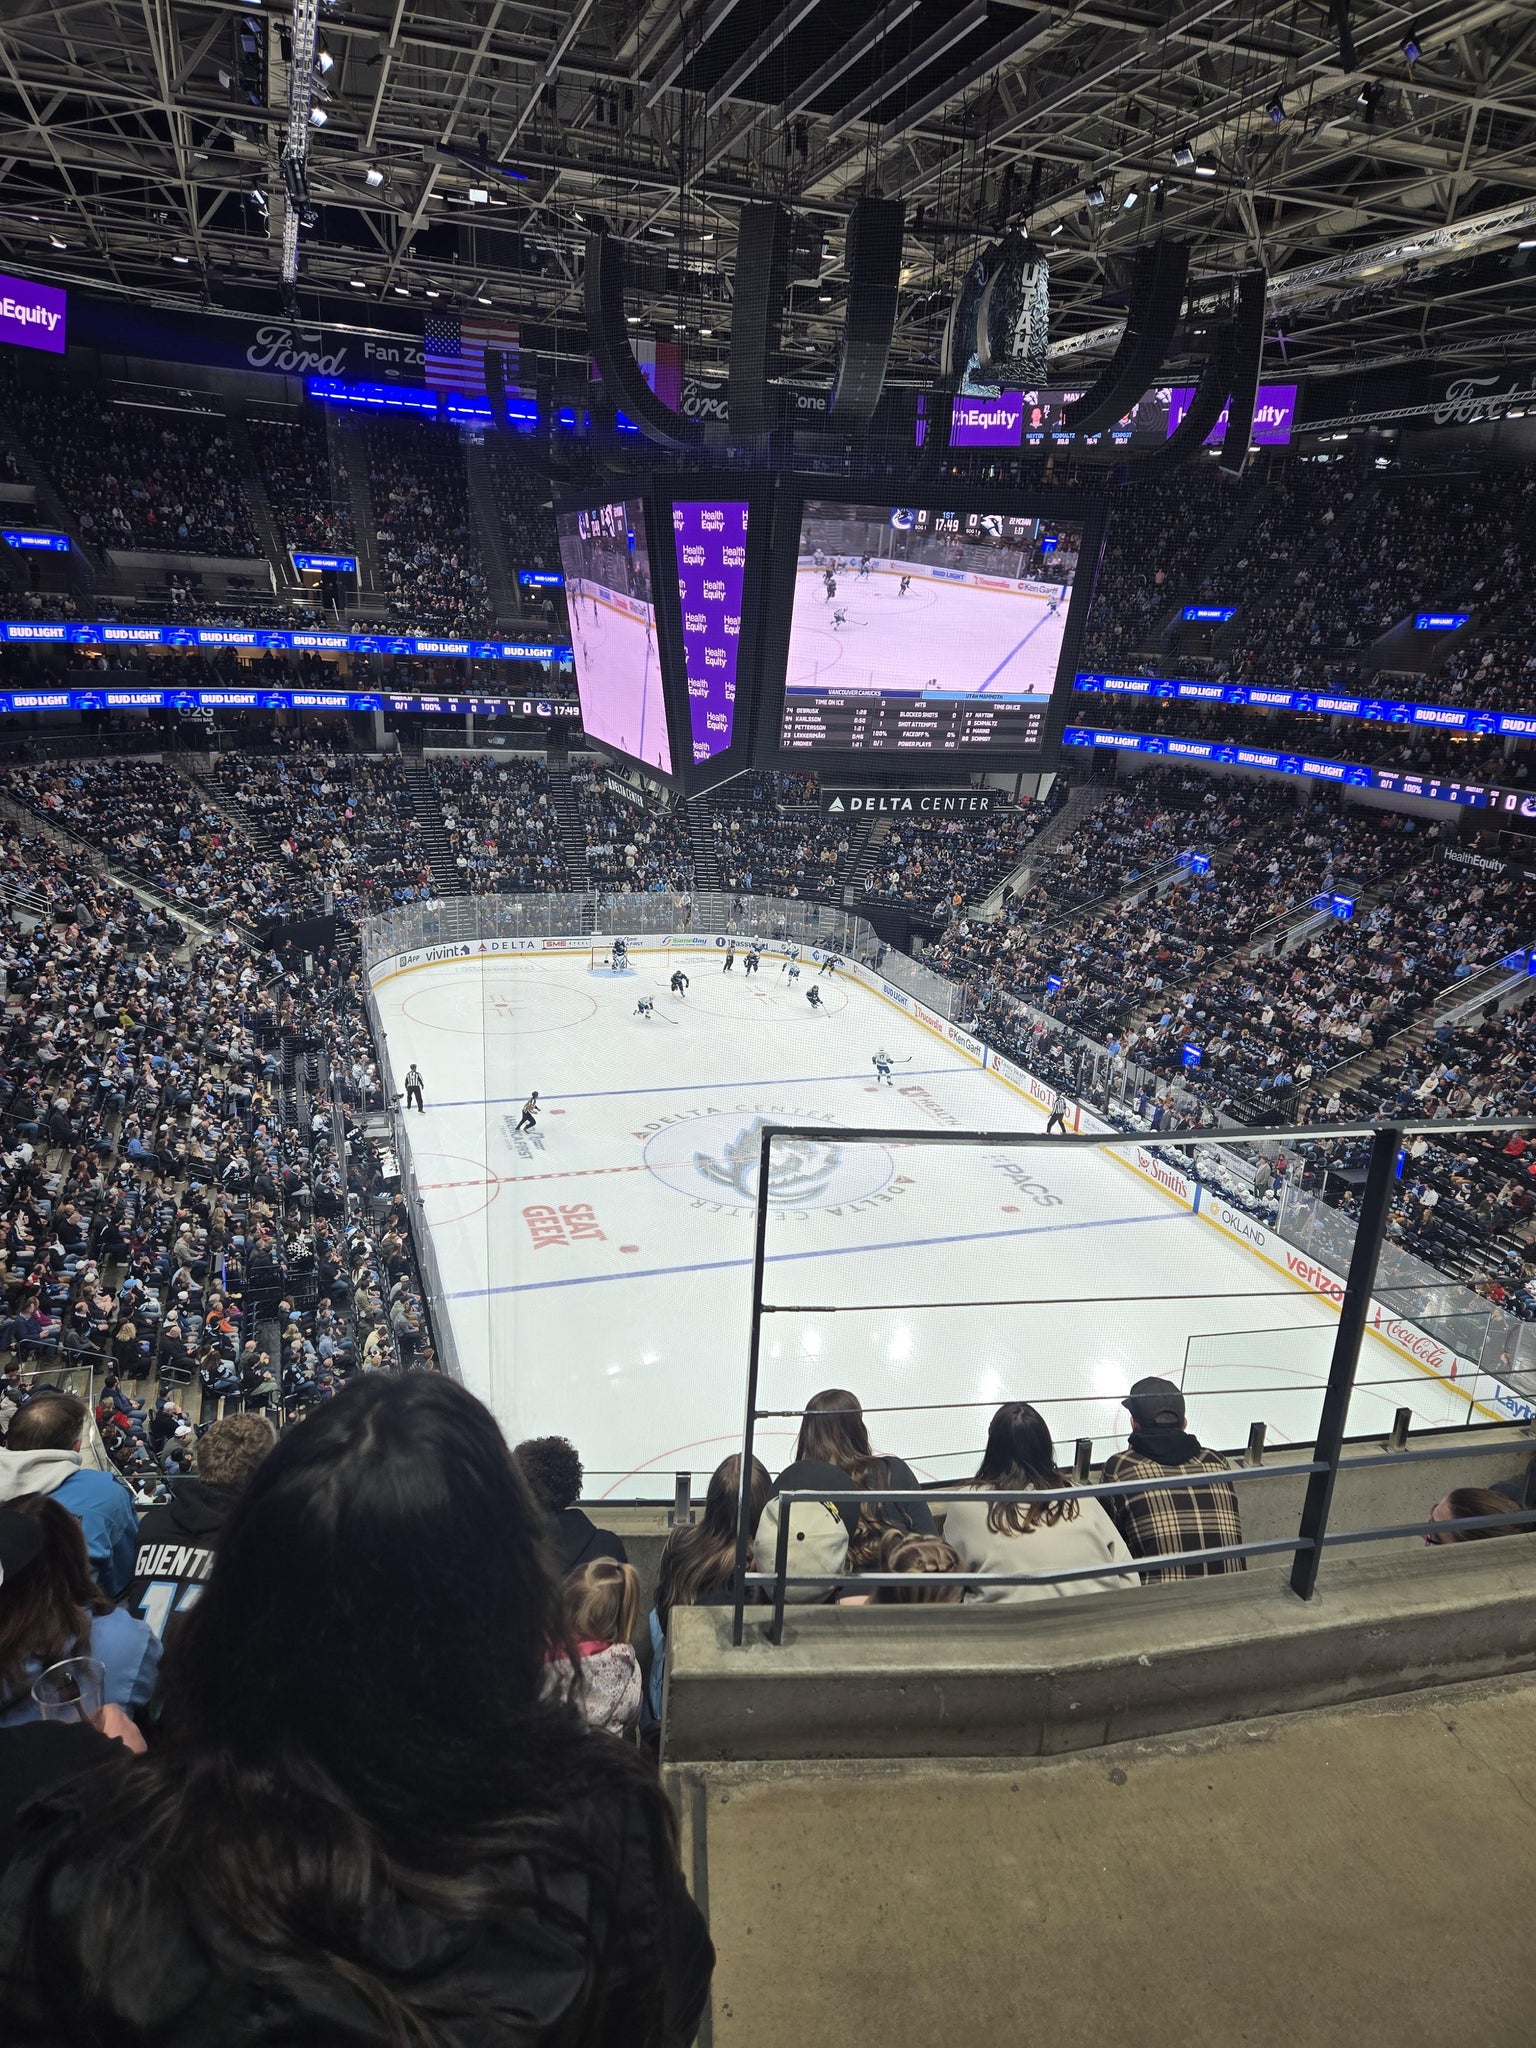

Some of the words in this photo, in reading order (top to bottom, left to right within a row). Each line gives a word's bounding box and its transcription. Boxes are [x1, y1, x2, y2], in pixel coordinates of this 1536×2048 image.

[1012, 262, 1040, 358] UTAH
[247, 326, 347, 376] Ford
[364, 342, 399, 362] Fan
[403, 351, 426, 366] Zo
[796, 391, 826, 410] one
[701, 510, 724, 520] Health
[935, 518, 959, 532] 17:49
[682, 544, 704, 555] Health
[703, 580, 724, 590] Health
[686, 612, 706, 623] Health
[9, 628, 34, 637] BUD
[34, 628, 64, 638] LIGHT
[105, 630, 128, 639] BUD
[130, 630, 160, 640] LIGHT
[200, 633, 223, 641] BUD
[224, 634, 254, 643] LIGHT
[293, 636, 316, 646] BUD
[317, 637, 347, 647] LIGHT
[418, 643, 439, 652] BUD
[439, 644, 468, 653] LIGHT
[504, 647, 524, 656] BUD
[525, 648, 552, 658] LIGHT
[705, 647, 726, 658] Health
[688, 678, 708, 688] Health
[1106, 680, 1124, 689] BUD
[1125, 682, 1149, 691] LIGHT
[1180, 686, 1198, 695] BUD
[1199, 688, 1222, 697] LIGHT
[14, 697, 38, 707] BUD
[39, 696, 68, 705] LIGHT
[108, 695, 131, 704] BUD
[132, 694, 162, 704] LIGHT
[201, 695, 224, 703] BUD
[225, 695, 255, 704] LIGHT
[293, 695, 316, 705] BUD
[317, 696, 347, 706] LIGHT
[1251, 692, 1268, 701] BUD
[1268, 694, 1290, 704] LIGHT
[522, 702, 531, 714] 0
[554, 706, 580, 716] 17:49
[1318, 699, 1335, 709] BUD
[1335, 701, 1358, 711] LIGHT
[707, 712, 727, 722] Health
[1416, 710, 1436, 720] BUD
[1437, 712, 1465, 724] LIGHT
[1502, 719, 1525, 731] BUD
[1525, 722, 1536, 732] LI
[1096, 735, 1114, 744] BUD
[1114, 737, 1139, 747] LIGHT
[1169, 743, 1187, 752] BUD
[1187, 744, 1210, 755] LIGHT
[1238, 753, 1255, 762] BUD
[1256, 755, 1278, 765] LIGHT
[1303, 763, 1320, 773] BUD
[1321, 765, 1344, 776] LIGHT
[1380, 779, 1392, 789] 0/1
[1403, 783, 1422, 795] 100%
[1505, 795, 1517, 810] 0
[851, 797, 913, 811] DELTA
[921, 797, 988, 810] CENTER
[1444, 848, 1504, 874] HealthEquity
[492, 941, 535, 950] DELTA
[884, 984, 893, 996] BUD
[894, 990, 907, 1006] LIGHT
[953, 1030, 965, 1047] Ken
[966, 1038, 981, 1056] Garff
[644, 1106, 717, 1131] DELTA
[736, 1104, 835, 1121] CENTER
[1151, 1160, 1187, 1198] Smith's
[824, 1186, 906, 1216] DELTA
[522, 1205, 570, 1250] GEEK
[559, 1203, 608, 1242] SEAT
[1222, 1210, 1265, 1246] OKLAND
[1286, 1251, 1344, 1302] verizo
